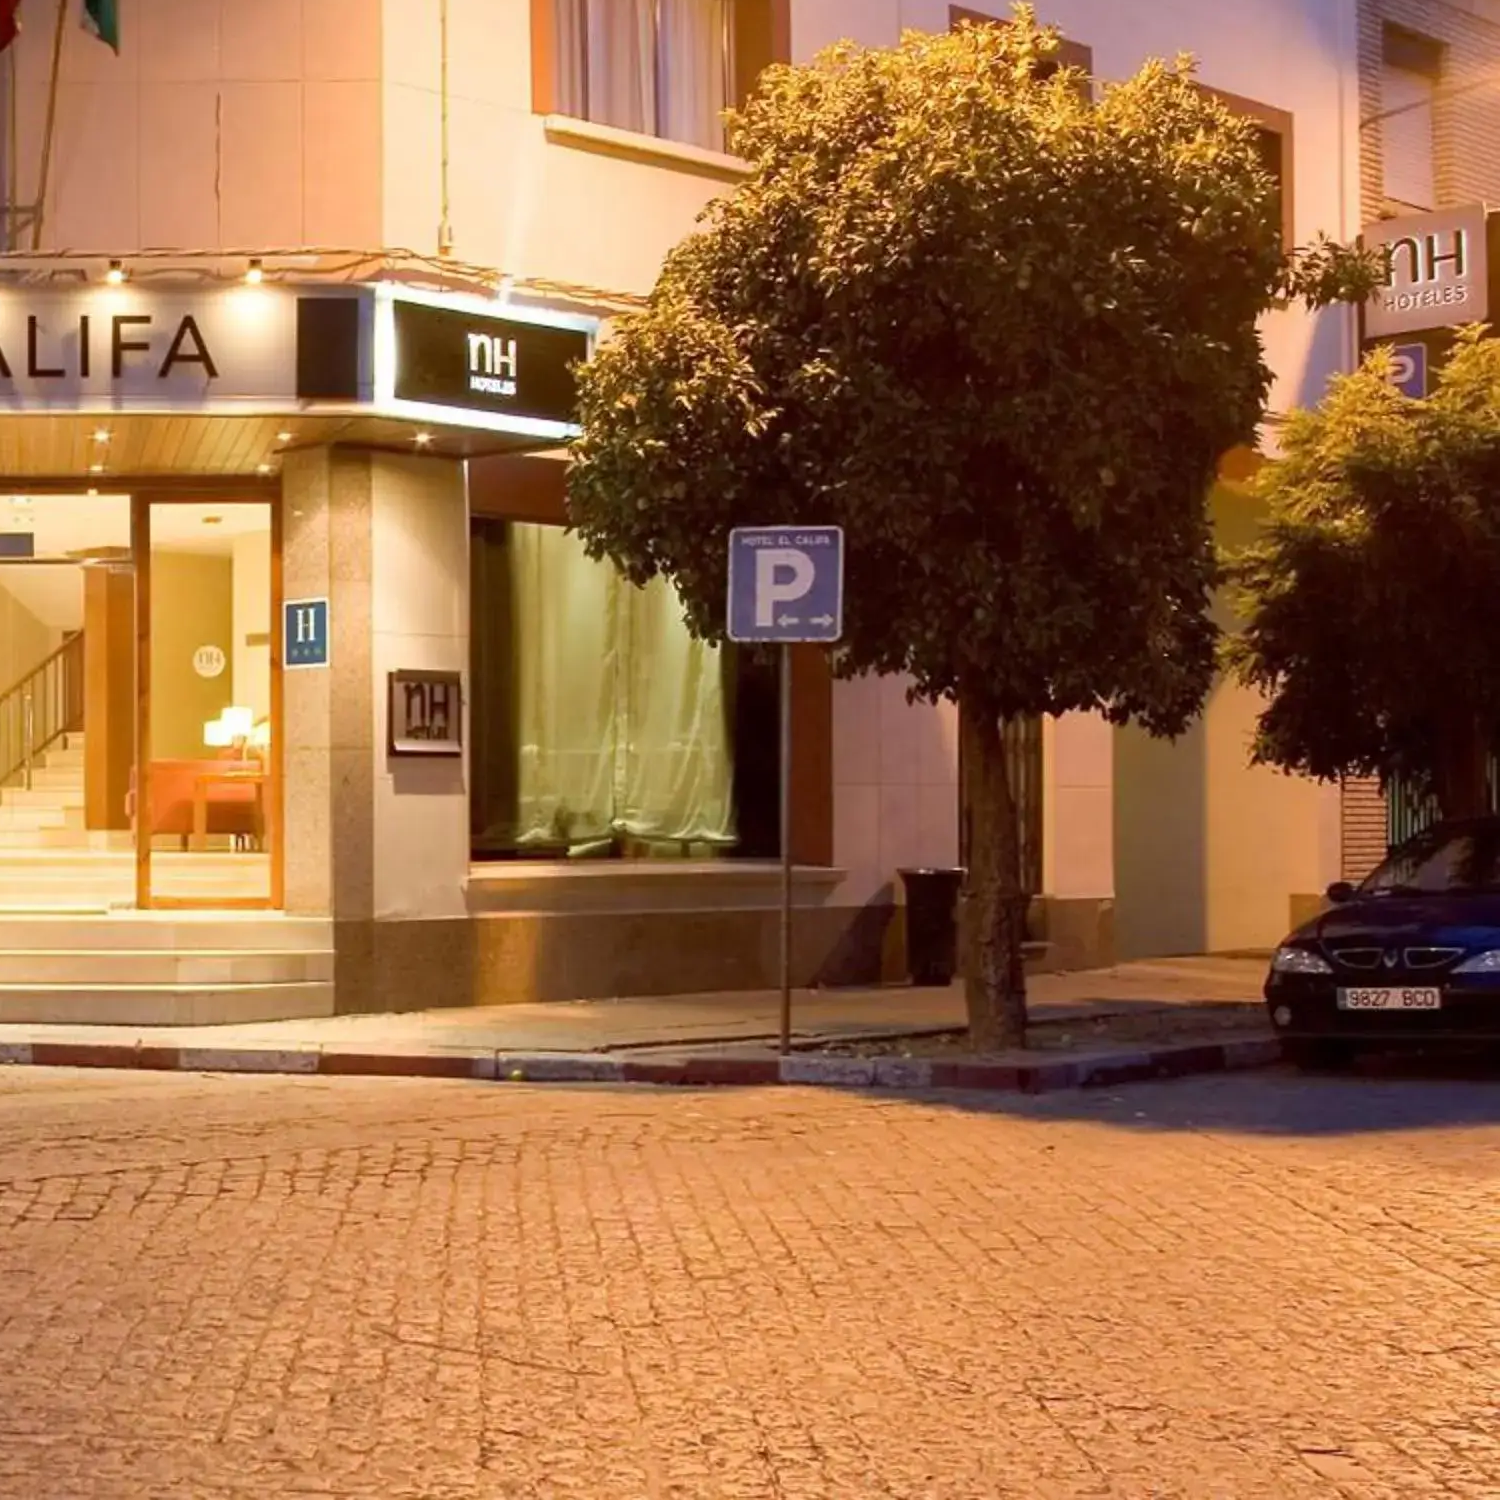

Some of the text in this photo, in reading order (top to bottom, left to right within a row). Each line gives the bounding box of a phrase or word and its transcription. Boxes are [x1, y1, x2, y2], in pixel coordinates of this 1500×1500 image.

[1385, 286, 1466, 312] HOTELES
[755, 549, 815, 627] P
[297, 608, 316, 643] H
